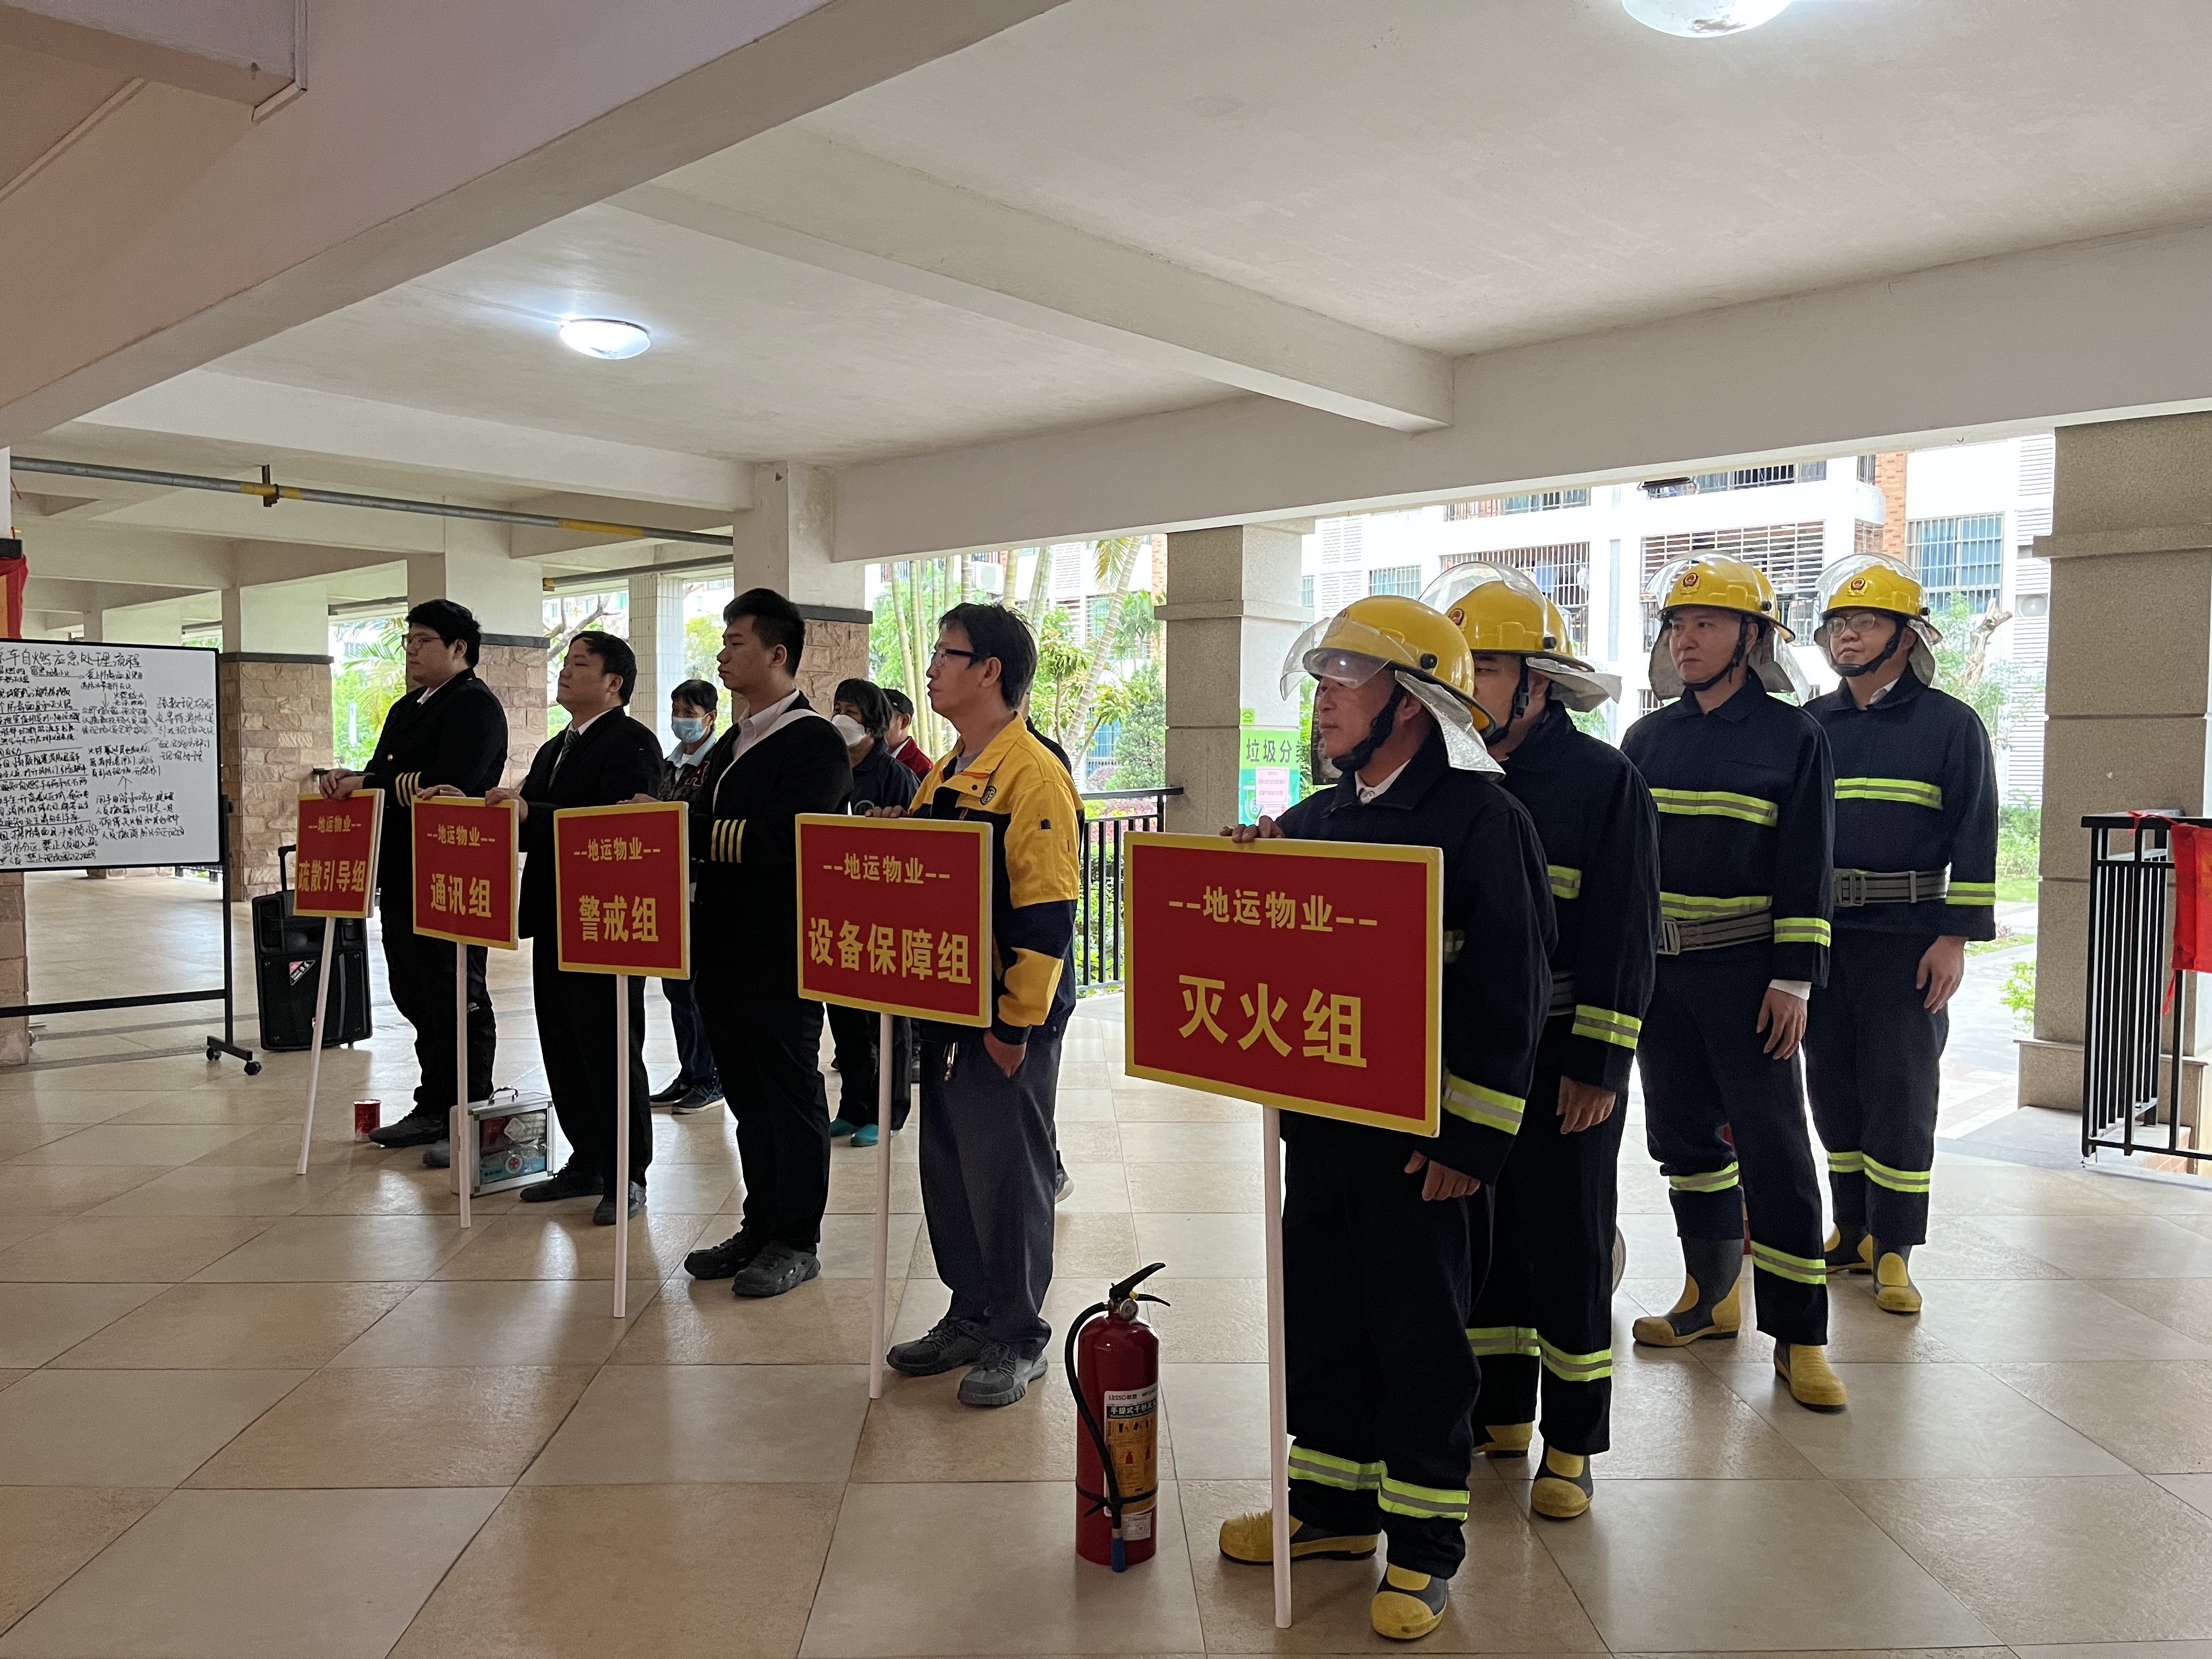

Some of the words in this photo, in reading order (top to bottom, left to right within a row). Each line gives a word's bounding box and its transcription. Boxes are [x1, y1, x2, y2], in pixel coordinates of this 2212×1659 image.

[298, 860, 366, 892] 疏散引导组
[431, 873, 492, 917] 通讯组
[579, 895, 659, 942] 警戒组
[808, 917, 971, 984] 设备保障组
[1178, 975, 1367, 1068] 灭火组
